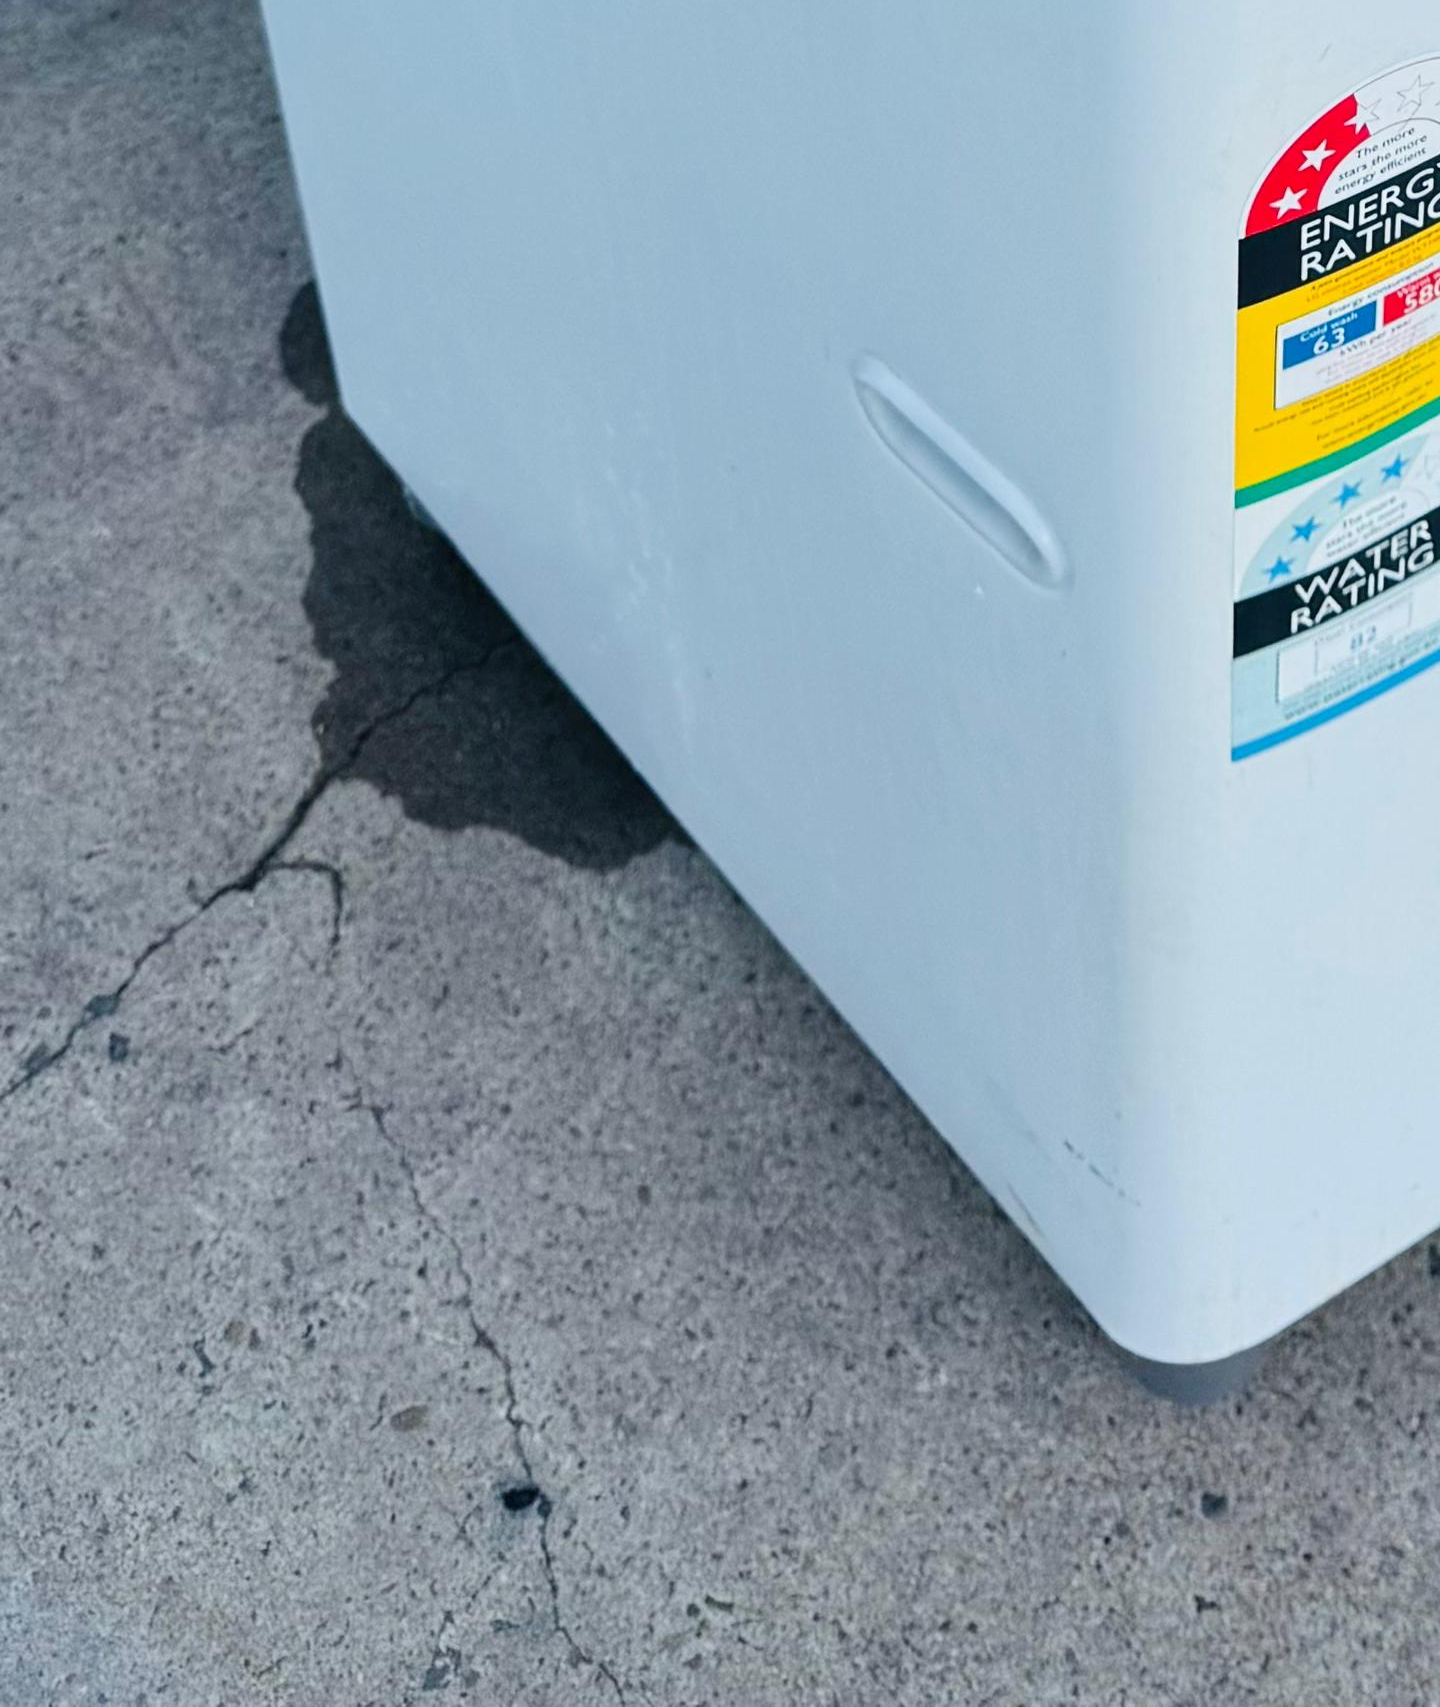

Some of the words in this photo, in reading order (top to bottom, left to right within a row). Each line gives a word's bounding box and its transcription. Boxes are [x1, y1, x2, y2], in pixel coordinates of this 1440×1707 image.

[1338, 162, 1368, 182] stars
[1372, 151, 1393, 166] the
[1395, 135, 1428, 155] more
[1356, 143, 1379, 159] The
[1382, 127, 1415, 147] more
[1334, 172, 1377, 195] energy
[1380, 147, 1427, 174] efficient
[1396, 277, 1431, 299] Warm
[1328, 297, 1364, 317] Energy
[1300, 324, 1328, 343] Cold
[1330, 312, 1358, 330] wash
[1313, 328, 1346, 356] 63
[1295, 520, 1432, 605] WATER
[1290, 541, 1435, 634] RATING
